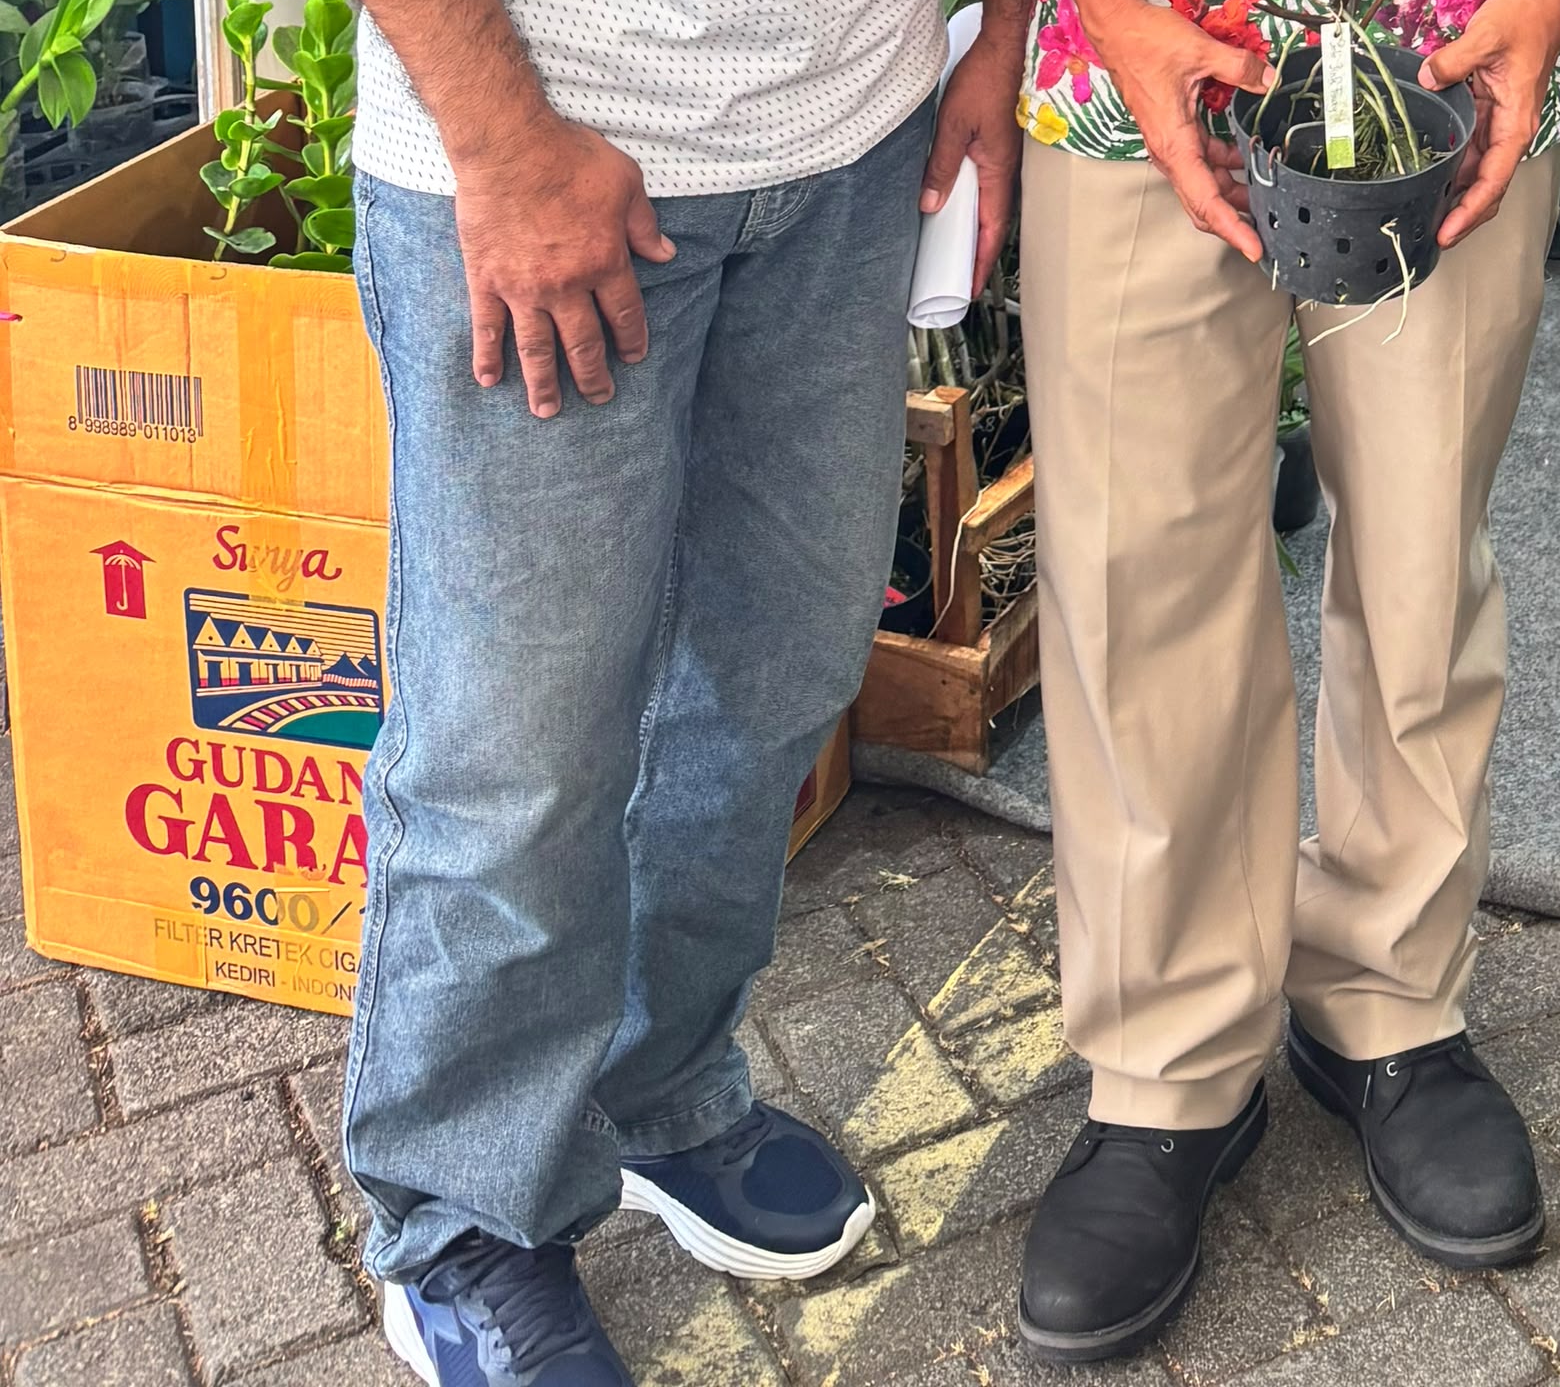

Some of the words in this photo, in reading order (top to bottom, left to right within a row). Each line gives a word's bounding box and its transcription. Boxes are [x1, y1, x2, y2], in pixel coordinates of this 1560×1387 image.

[68, 415, 78, 432] 8
[85, 417, 137, 438] 998989
[144, 423, 197, 444] 011013
[212, 524, 343, 594] Surya
[154, 917, 223, 950] FILTER
[230, 930, 313, 966] KRETEK
[215, 960, 276, 988] KEDIRI
